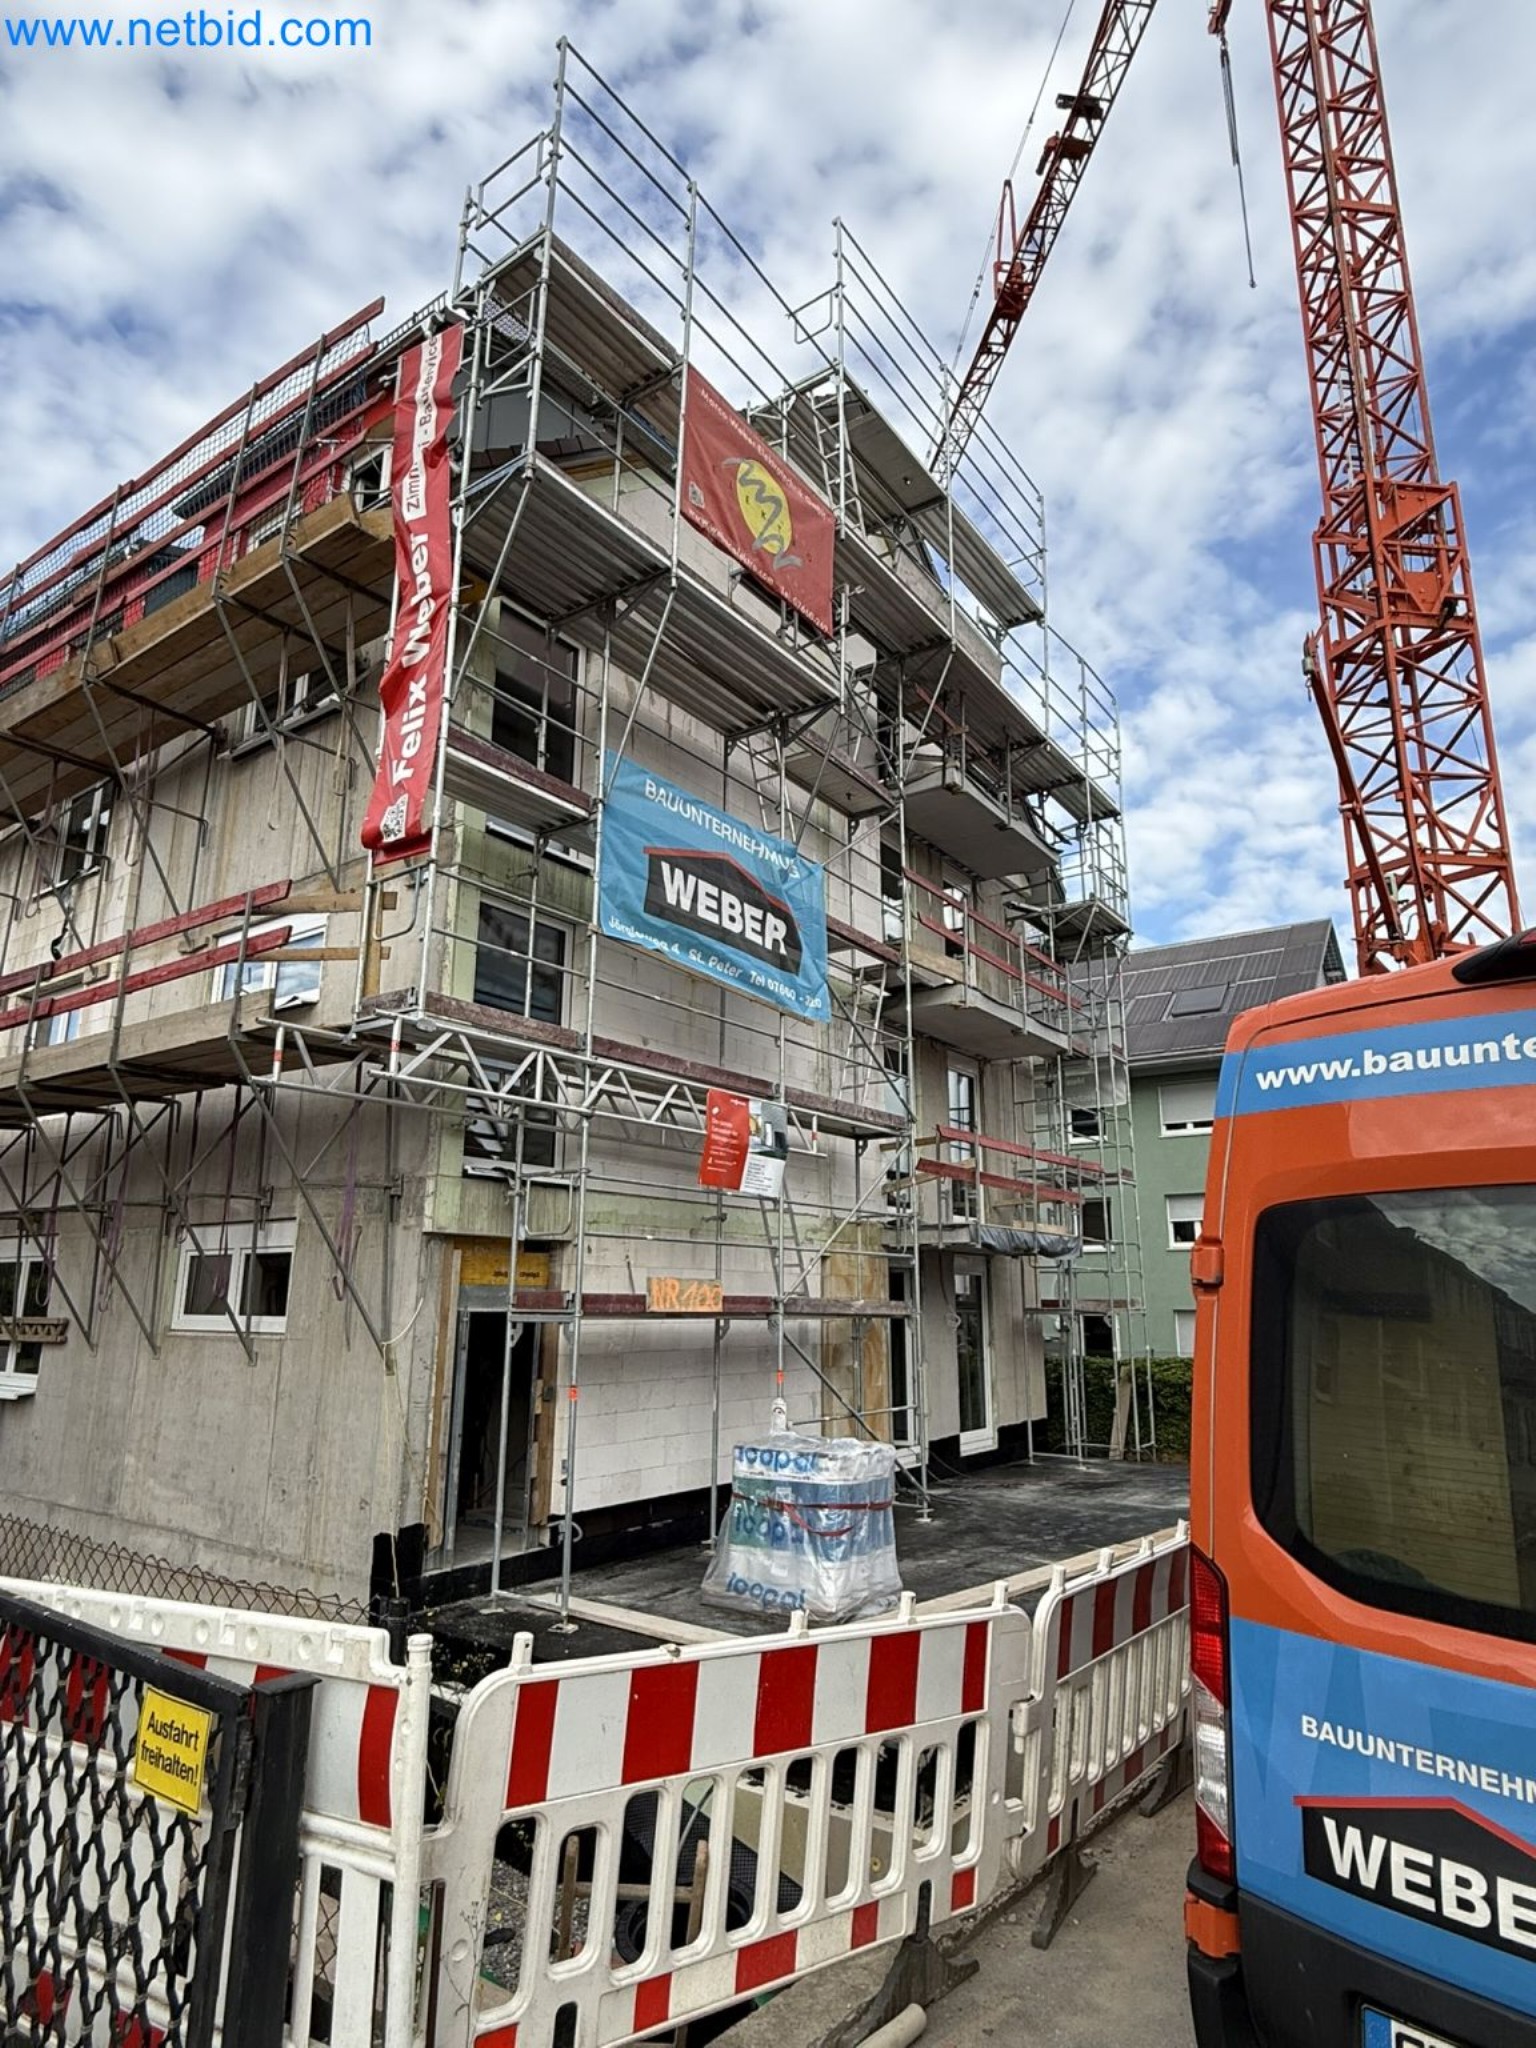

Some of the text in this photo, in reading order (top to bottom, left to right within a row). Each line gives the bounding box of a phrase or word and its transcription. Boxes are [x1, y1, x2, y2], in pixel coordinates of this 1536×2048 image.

[392, 532, 436, 786] Felix Weber
[660, 861, 787, 955] WEBER
[708, 955, 743, 978] Peter
[146, 1710, 200, 1752] Ausfahrt
[140, 1740, 200, 1786] freihalten!
